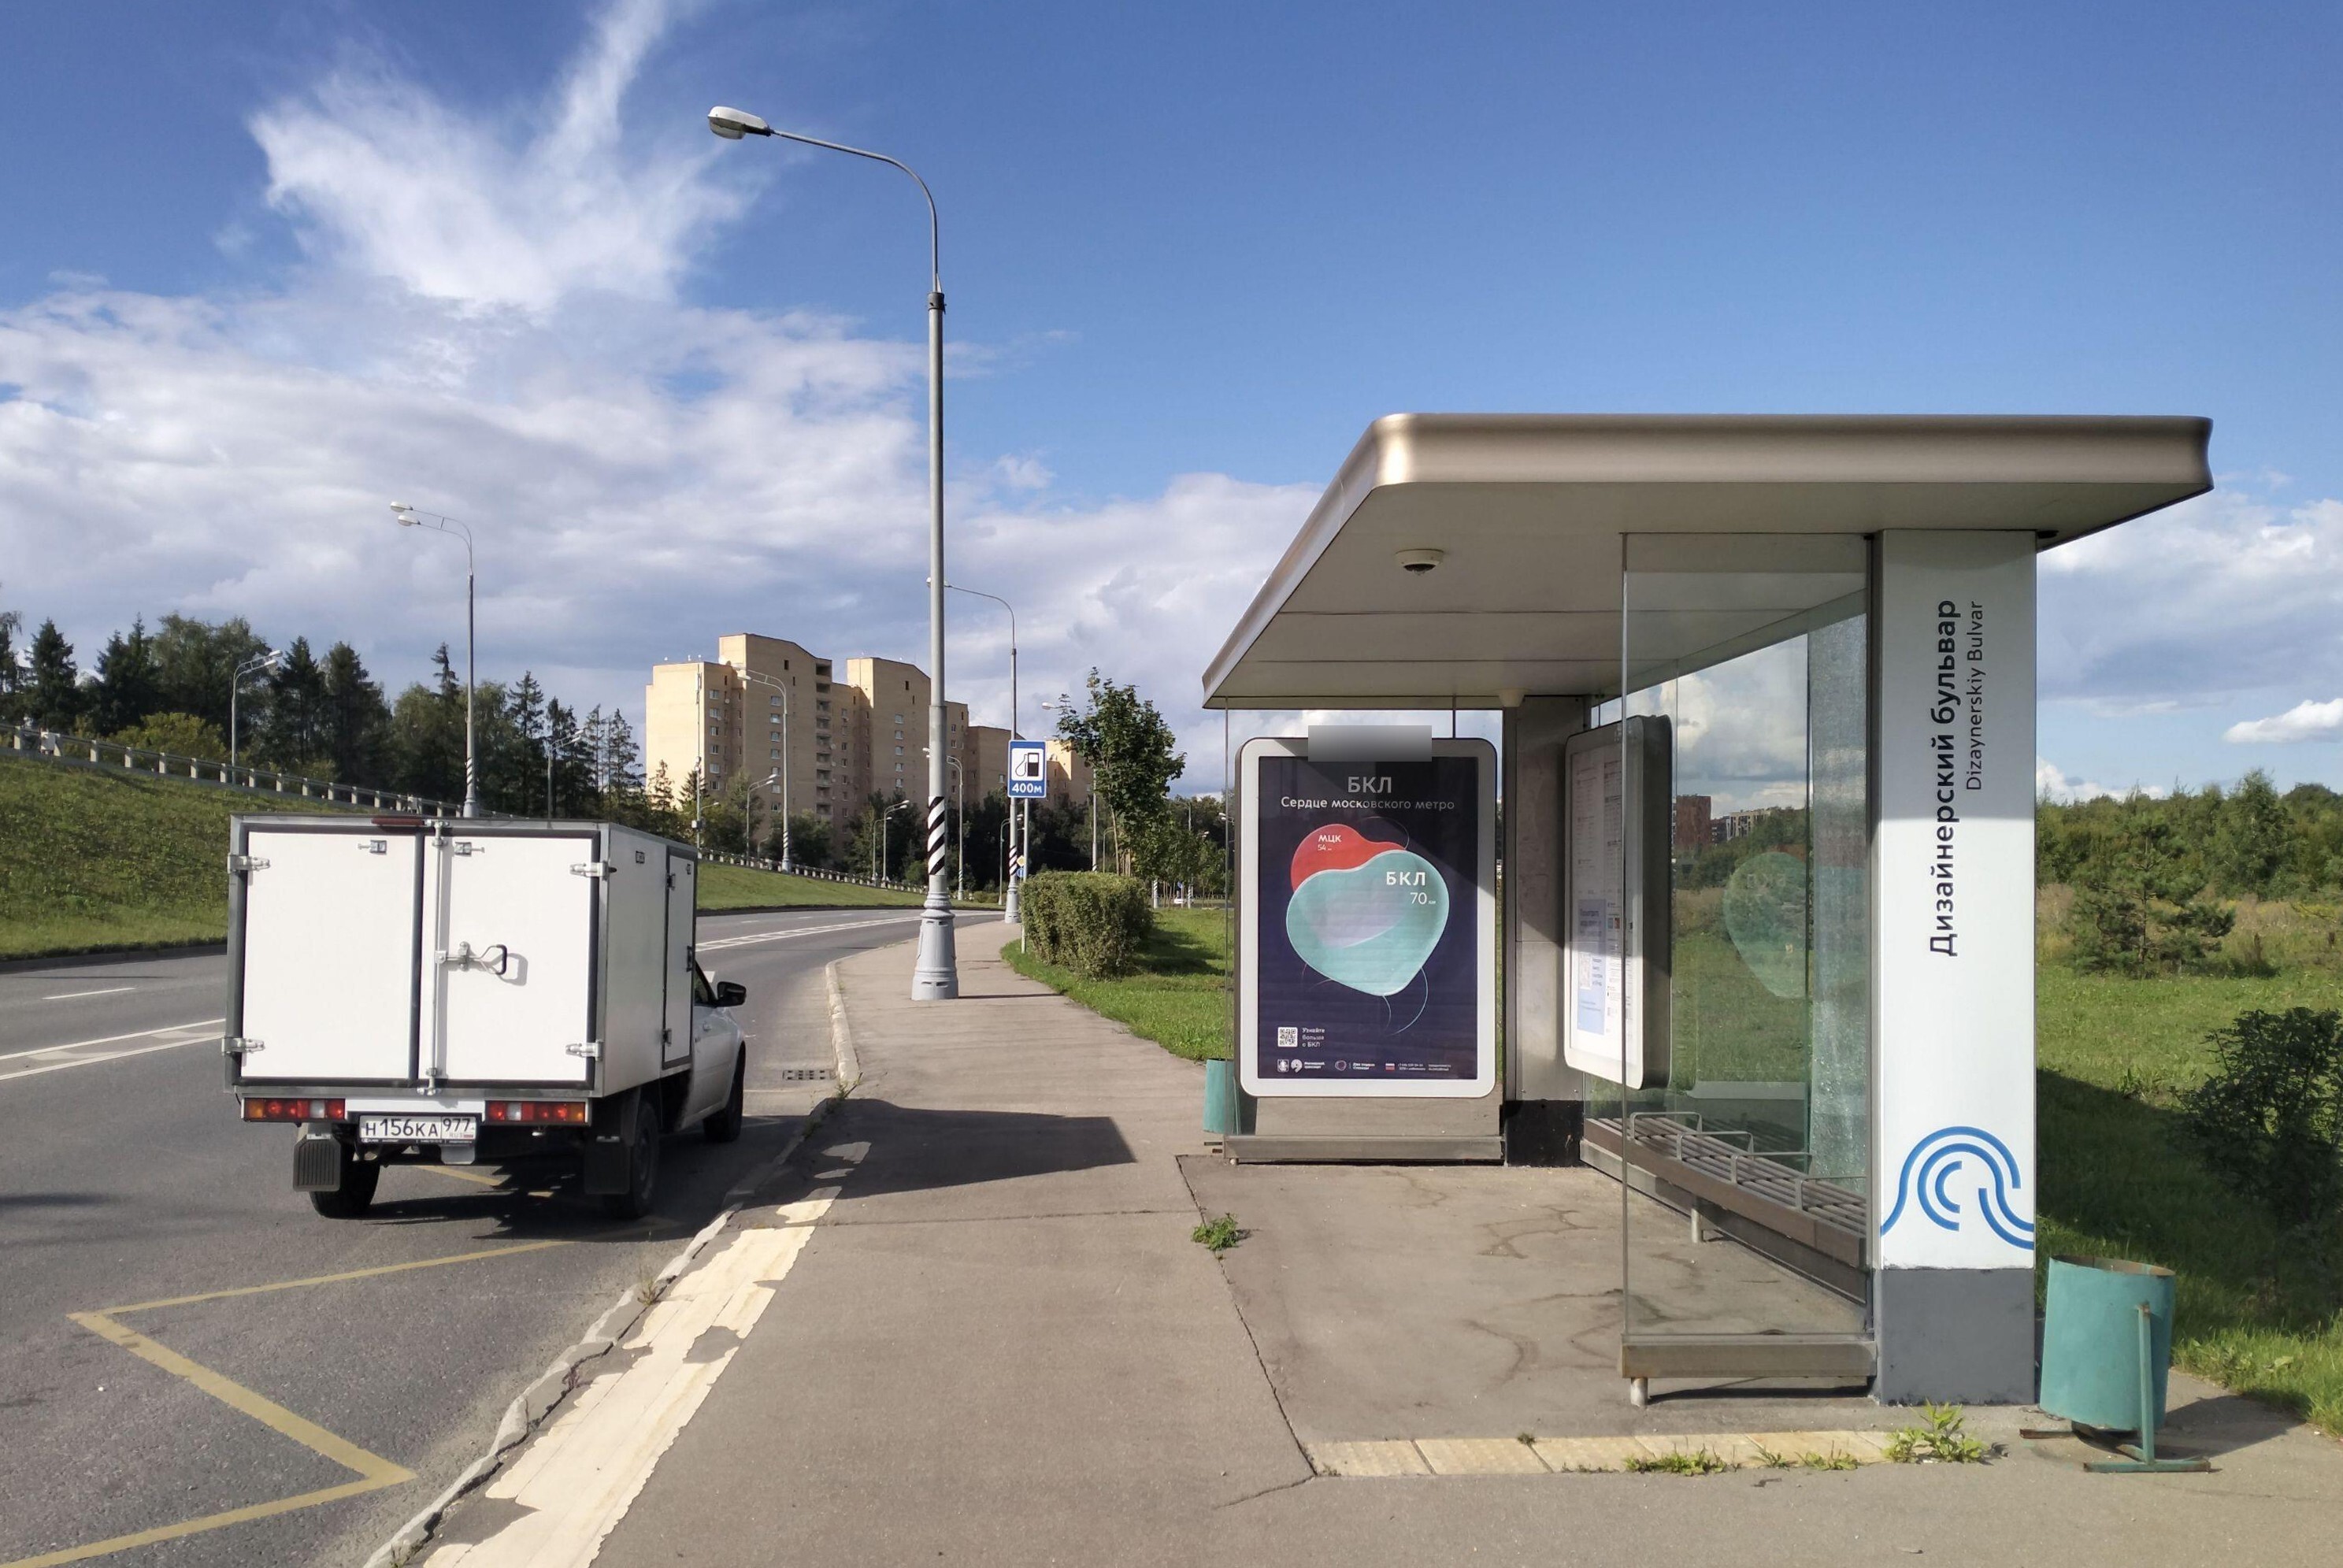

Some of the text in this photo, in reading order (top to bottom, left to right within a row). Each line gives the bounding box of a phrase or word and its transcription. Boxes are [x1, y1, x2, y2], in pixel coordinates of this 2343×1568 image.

[1966, 601, 1986, 791] Dizaynerskiy Bulvar
[1348, 776, 1392, 794] БКЛ
[1930, 600, 1961, 956] Дизайнерский бульвар
[1011, 782, 1043, 793] 400м
[1281, 796, 1455, 811] Сердце московского метро
[1318, 834, 1342, 844] МЦК
[1386, 871, 1425, 886] БКЛ
[1410, 891, 1427, 905] 70
[443, 1118, 470, 1132] 977
